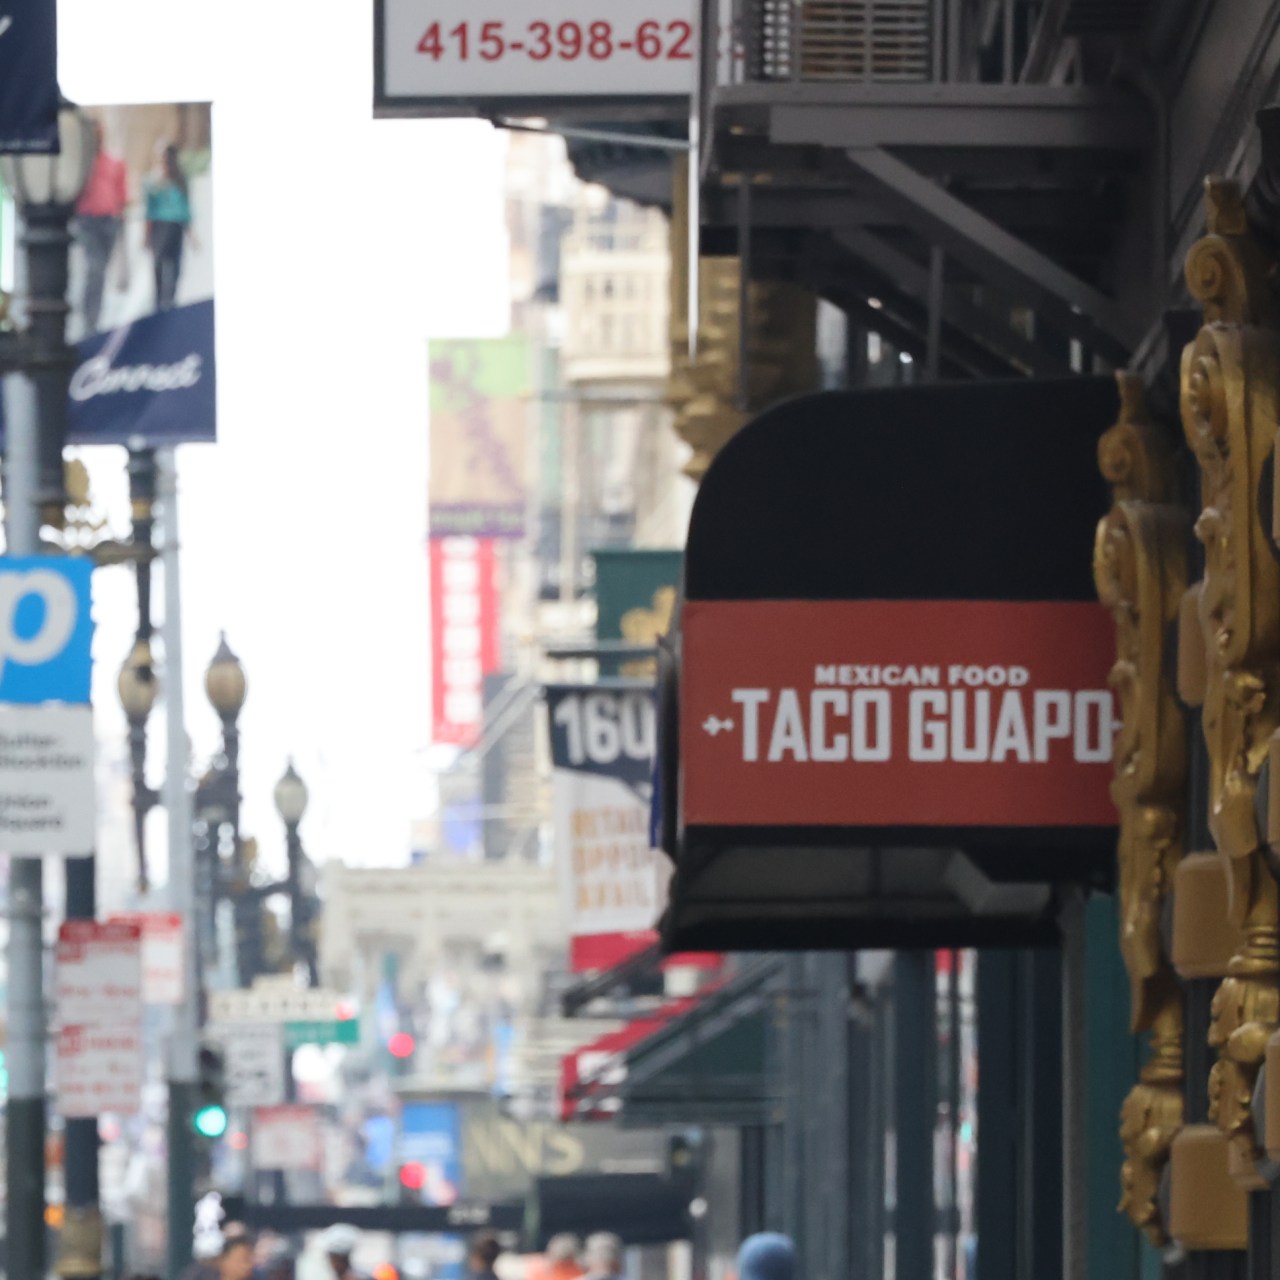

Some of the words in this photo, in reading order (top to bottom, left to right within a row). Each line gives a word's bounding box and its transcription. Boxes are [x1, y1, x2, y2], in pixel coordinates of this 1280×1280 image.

[416, 20, 744, 61] 415-398-62
[814, 665, 939, 686] MEXICAN
[948, 666, 1030, 686] FOOD
[732, 688, 891, 763] TACO
[908, 688, 1114, 764] GUAPO
